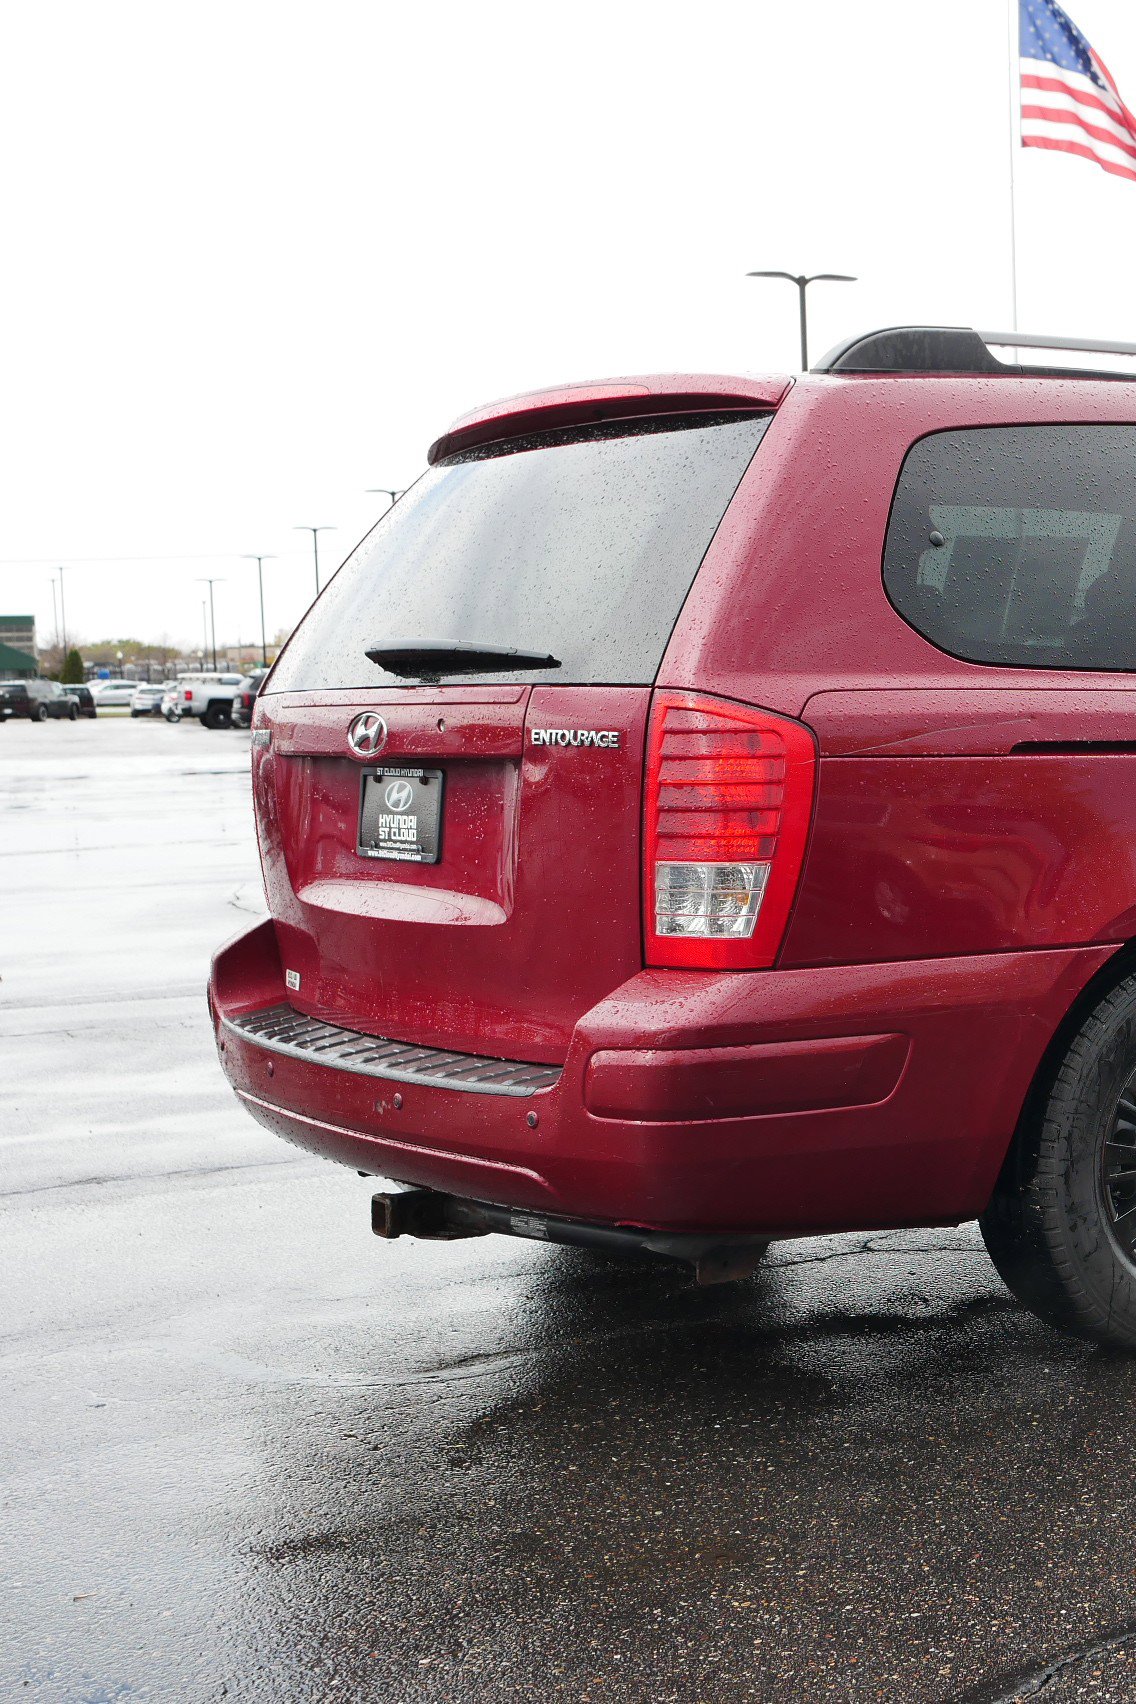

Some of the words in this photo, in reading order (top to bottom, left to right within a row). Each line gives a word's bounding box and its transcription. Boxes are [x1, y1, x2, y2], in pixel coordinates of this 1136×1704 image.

[531, 728, 620, 748] ENTOURAGE
[401, 768, 423, 776] HYUNDAI
[378, 814, 417, 829] HYUNDAI
[379, 828, 390, 840] ST
[391, 828, 417, 841] CLOUD
